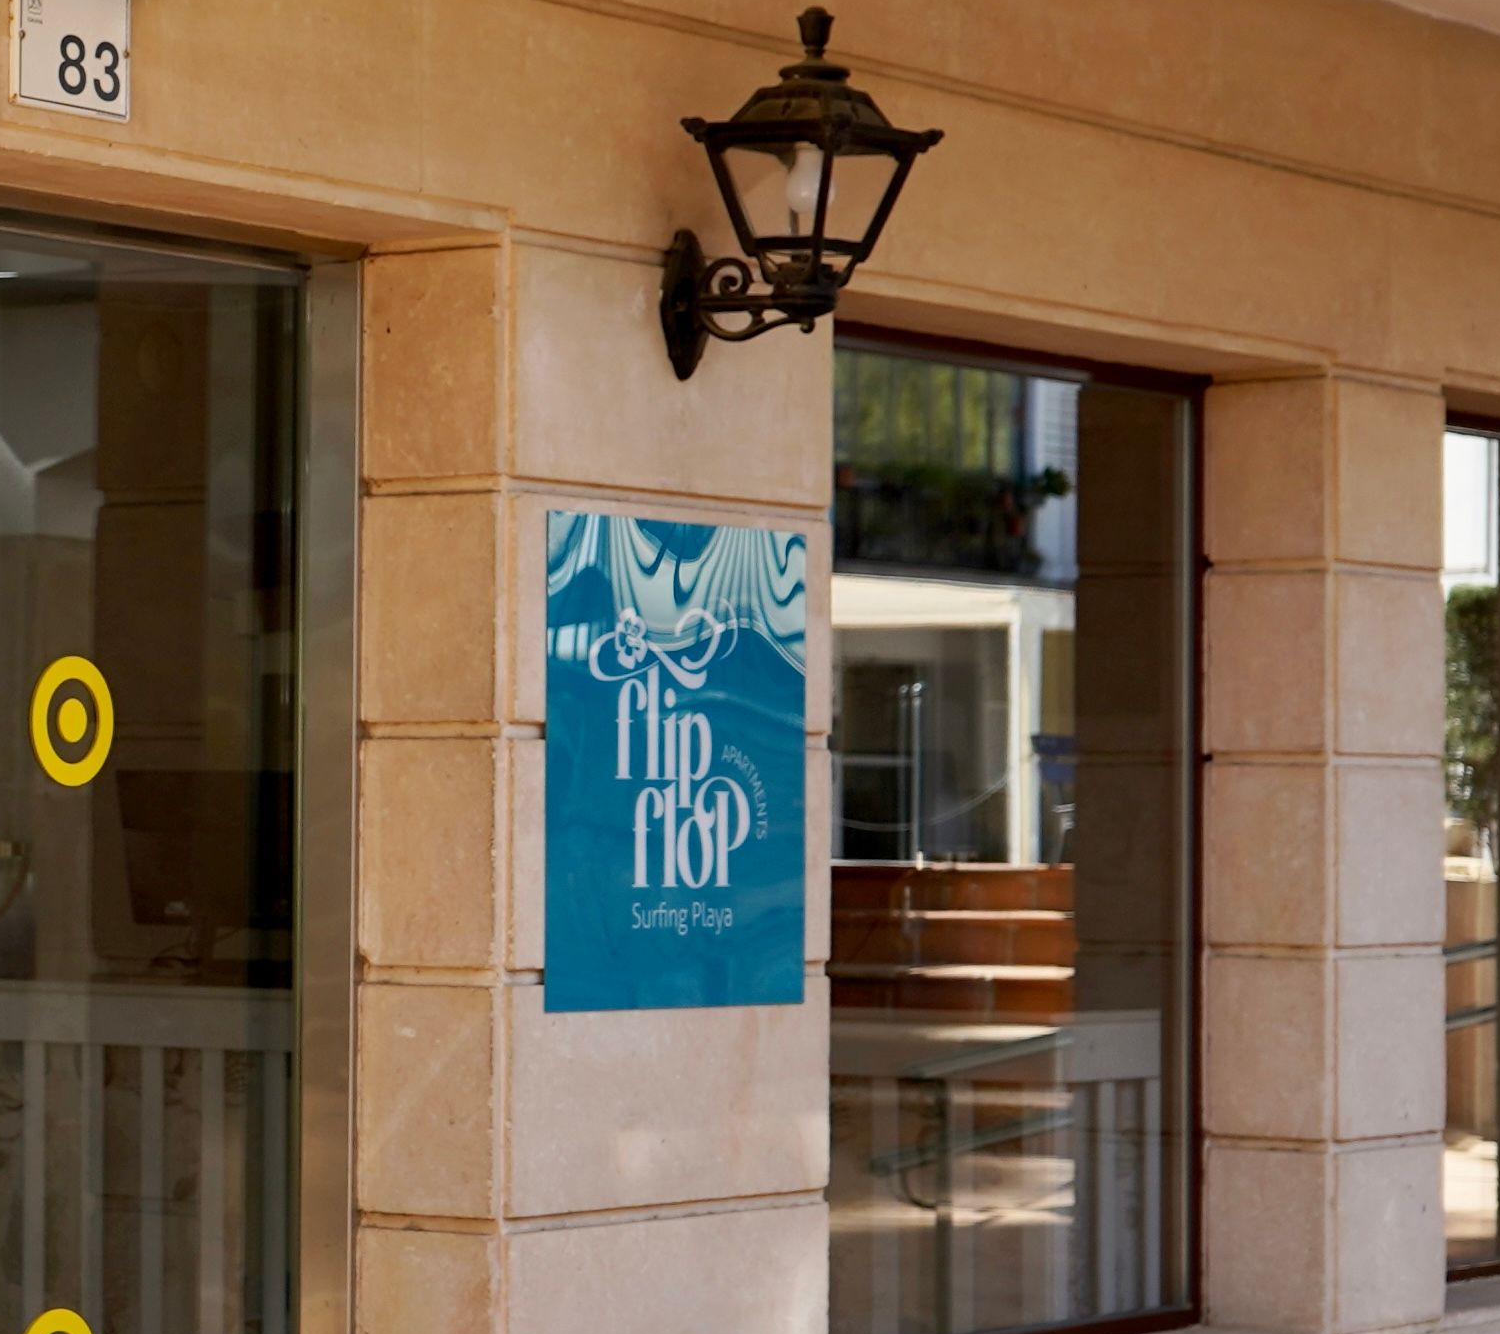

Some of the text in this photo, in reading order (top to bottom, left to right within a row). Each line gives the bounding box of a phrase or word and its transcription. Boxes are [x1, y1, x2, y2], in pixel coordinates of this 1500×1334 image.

[59, 35, 121, 102] 83
[614, 667, 713, 808] flip
[720, 744, 768, 840] APARTMENTS
[631, 902, 733, 935] Surfing Playa
